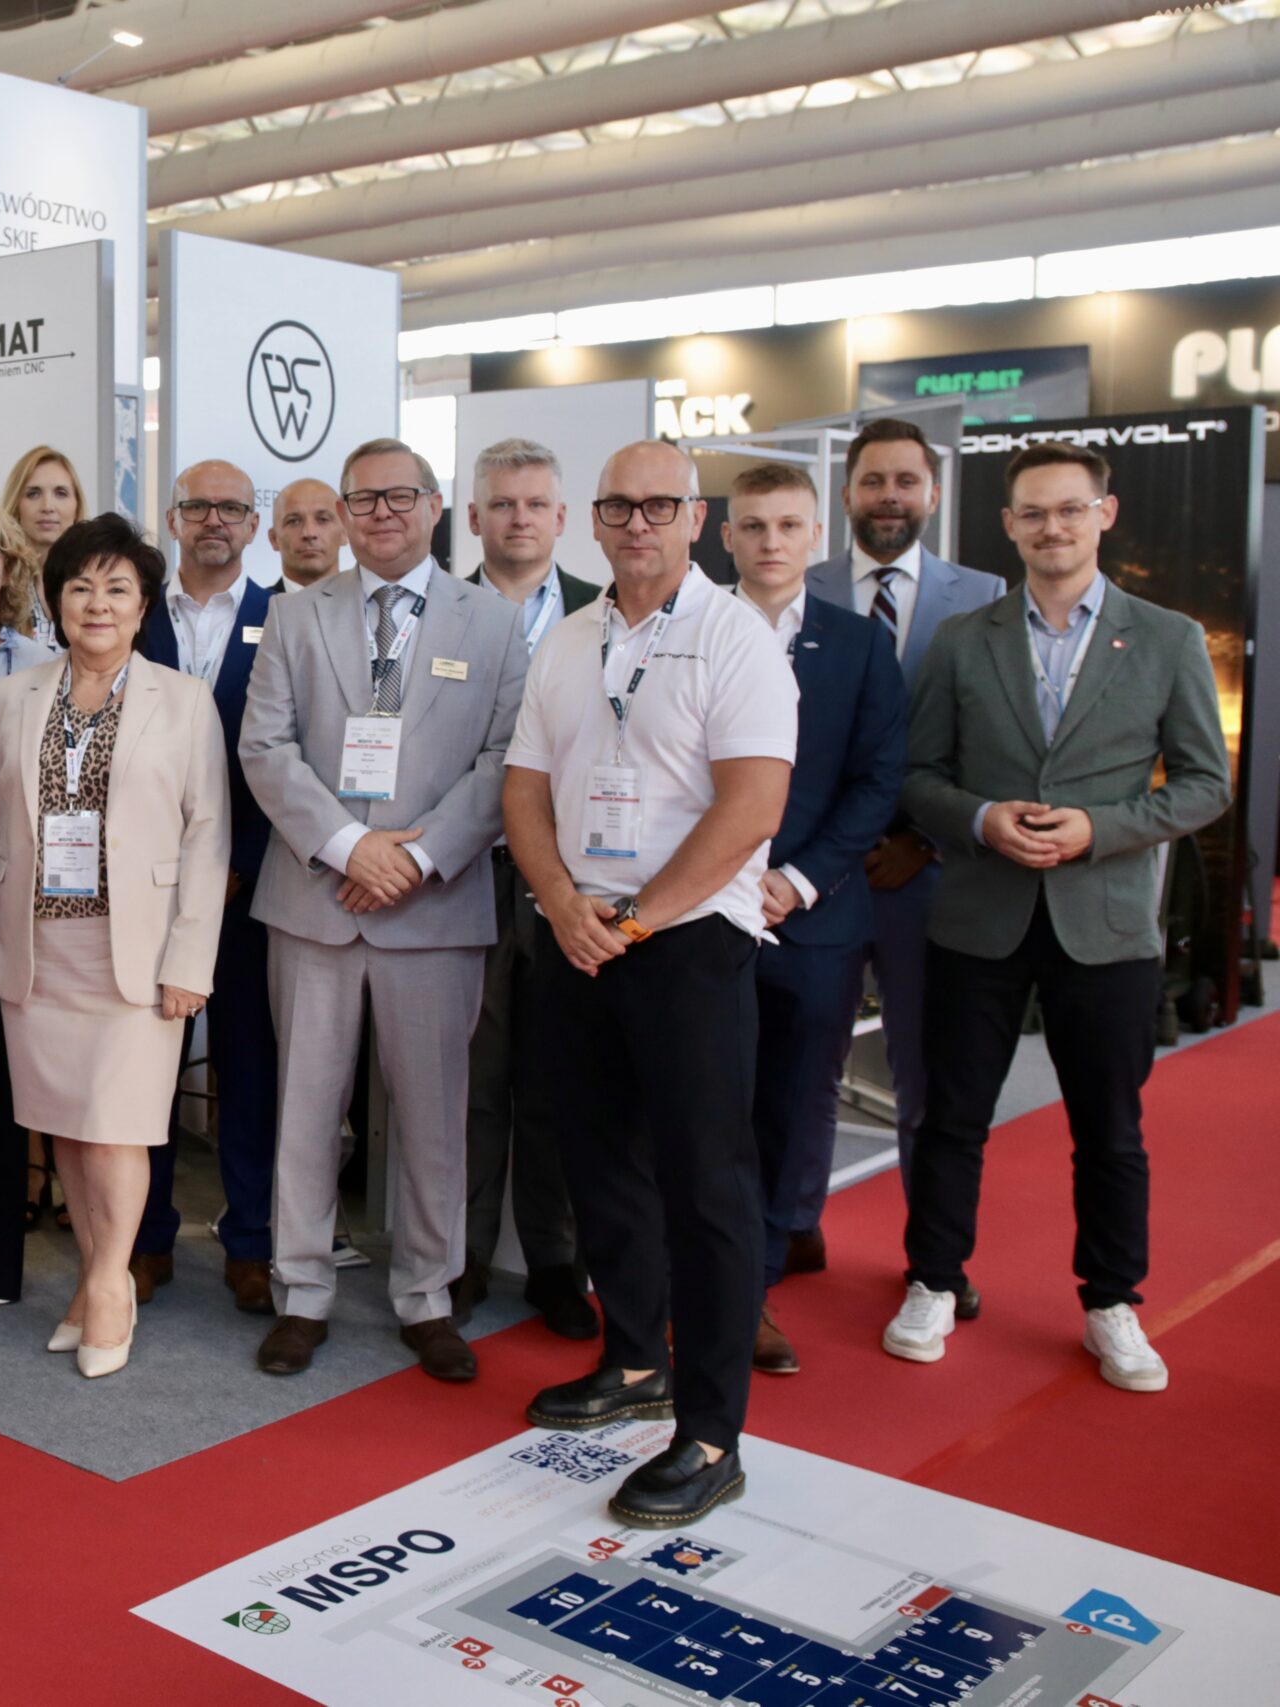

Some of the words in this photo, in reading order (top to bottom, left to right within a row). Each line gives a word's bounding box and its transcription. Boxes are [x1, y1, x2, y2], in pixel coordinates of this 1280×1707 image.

[24, 361, 46, 375] CNC
[600, 1541, 615, 1549] 4
[249, 1543, 350, 1588] Welcome
[350, 1533, 372, 1547] to
[277, 1530, 455, 1612] MSPO
[550, 1592, 585, 1609] 10
[652, 1600, 680, 1614] 2
[1104, 1614, 1137, 1632] P
[596, 1628, 630, 1640] 1
[739, 1632, 765, 1645] 4
[964, 1628, 993, 1642] 9
[463, 1642, 481, 1652] 3
[681, 1662, 718, 1676] 3
[905, 1664, 945, 1678] 8
[552, 1680, 573, 1691] 2
[792, 1671, 821, 1686] 5
[882, 1682, 919, 1697] 7
